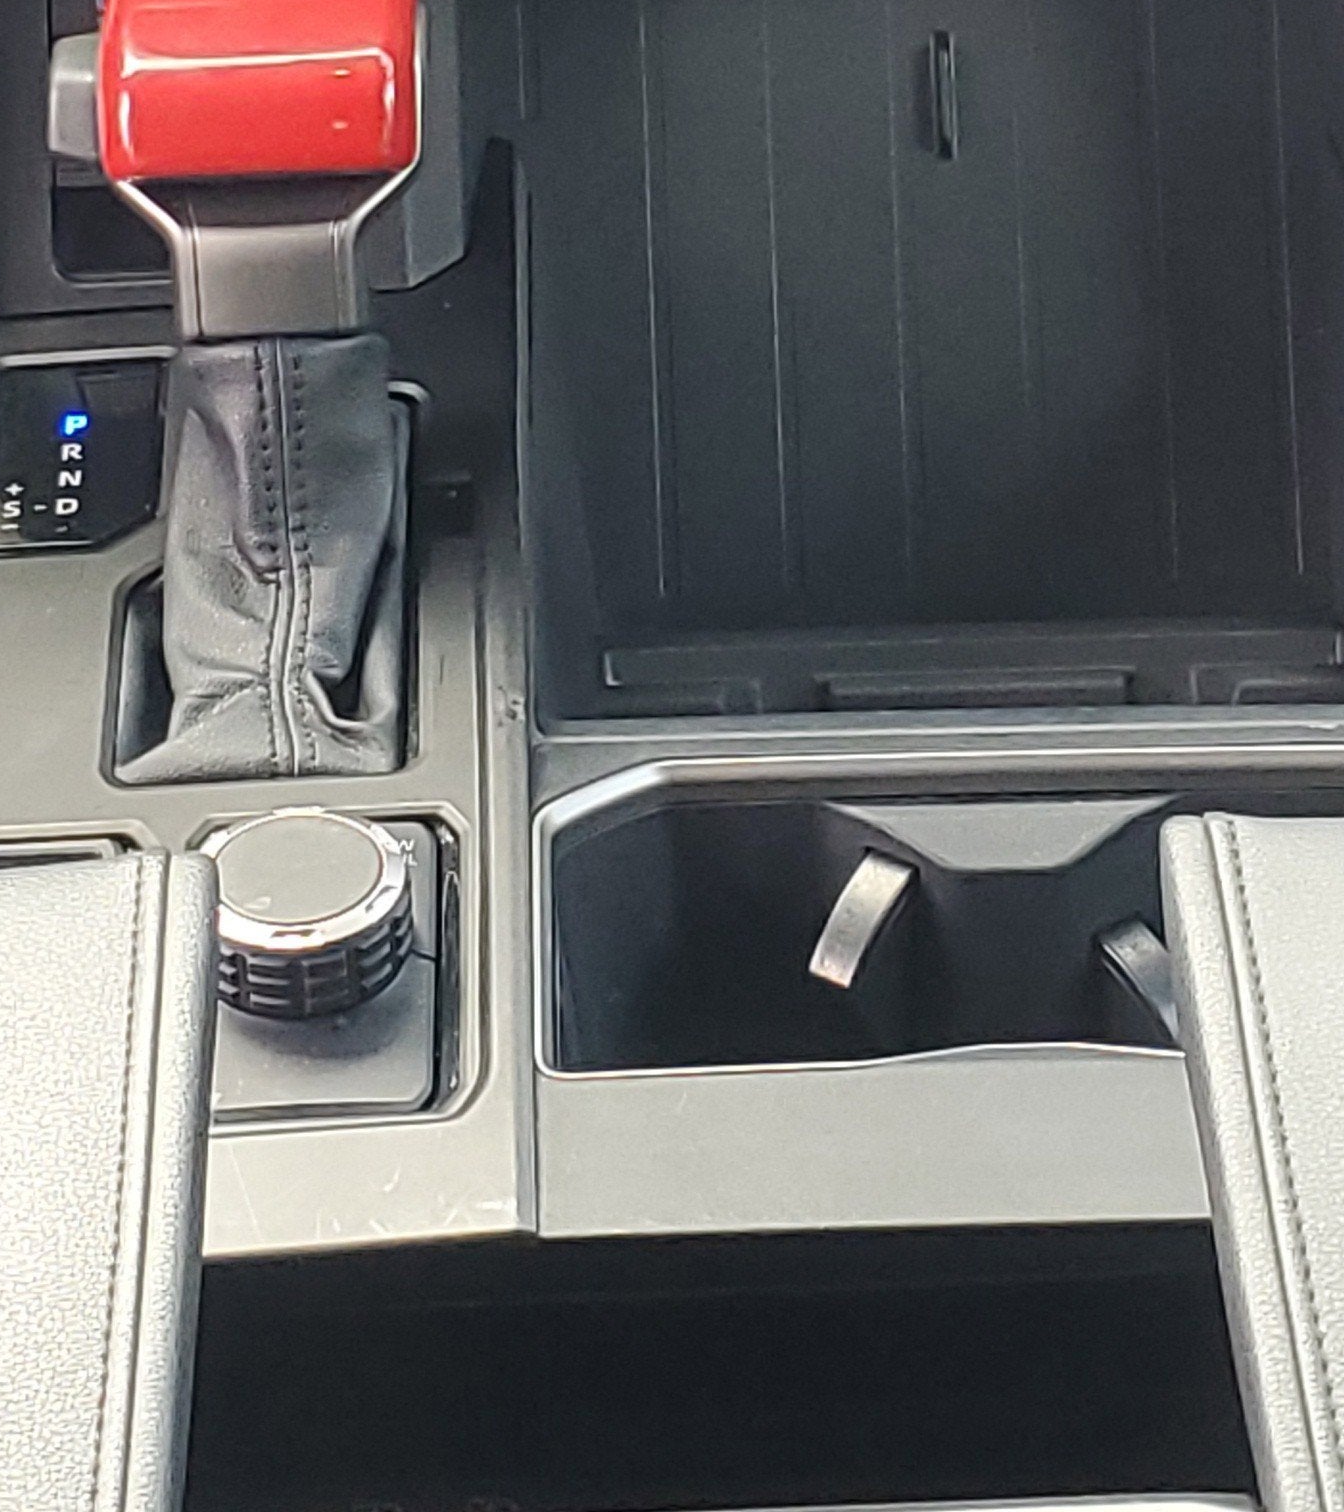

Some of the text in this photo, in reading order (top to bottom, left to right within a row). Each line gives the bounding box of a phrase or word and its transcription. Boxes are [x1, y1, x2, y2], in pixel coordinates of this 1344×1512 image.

[65, 415, 88, 436] P
[61, 443, 83, 462] R
[58, 470, 83, 488] N
[2, 500, 21, 519] S
[55, 498, 79, 515] D
